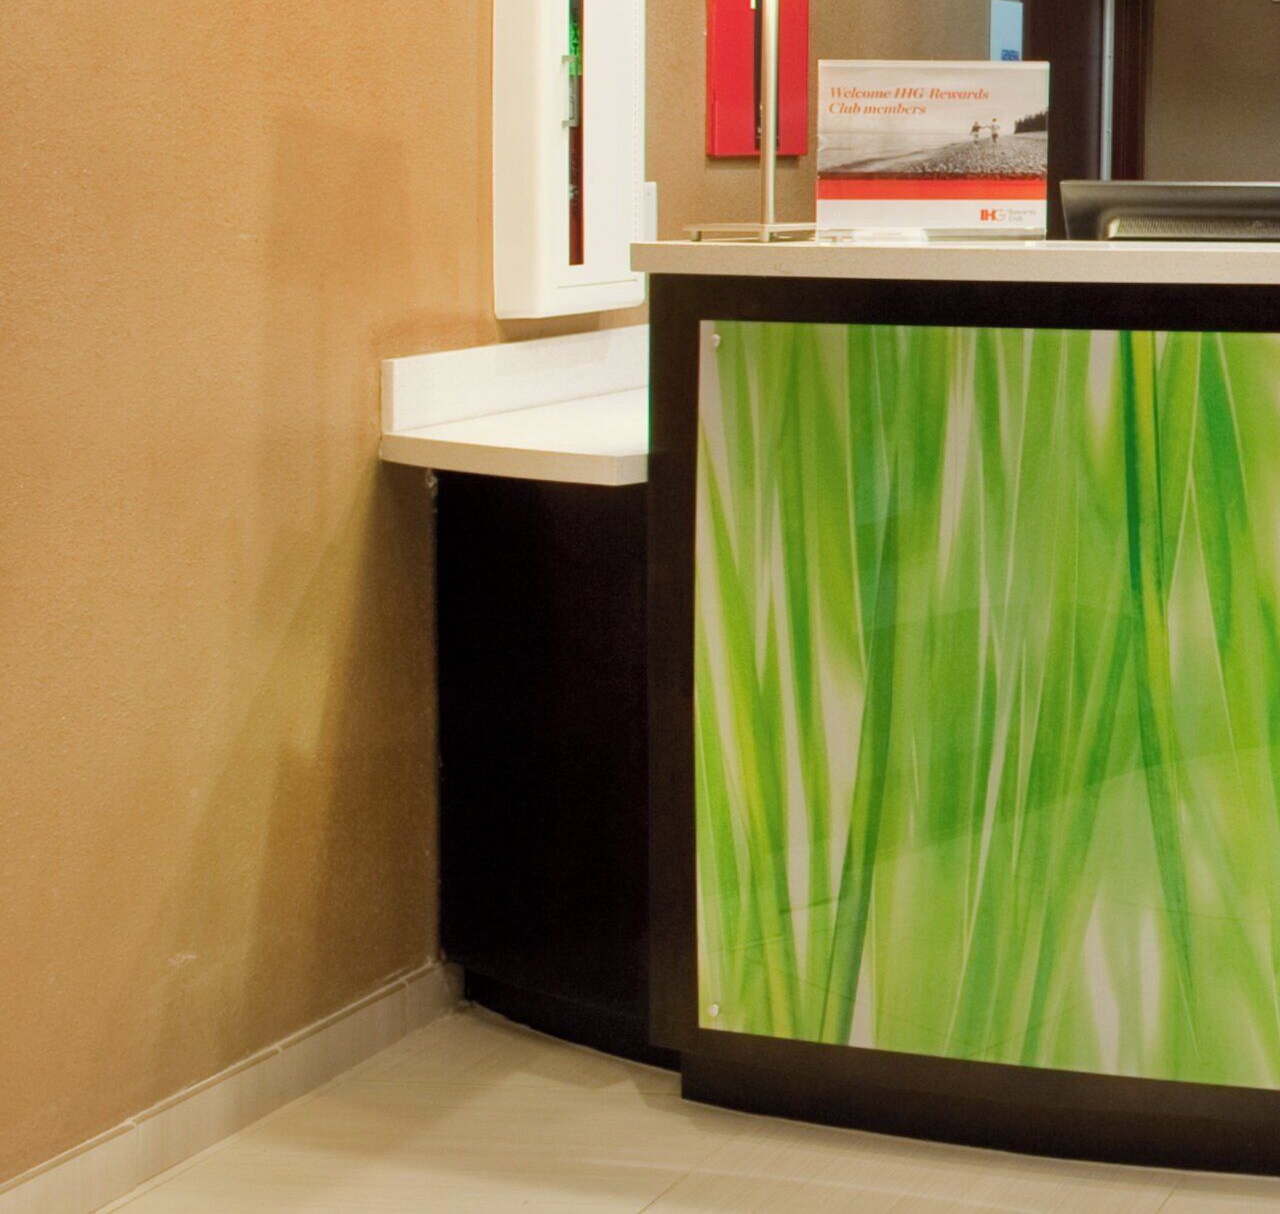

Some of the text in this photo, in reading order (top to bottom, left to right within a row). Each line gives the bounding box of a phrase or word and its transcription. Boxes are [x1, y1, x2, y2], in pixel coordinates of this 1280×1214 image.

[830, 87, 989, 100] Welcome IHG Rewards
[828, 101, 927, 115] Club members
[980, 208, 1006, 222] IHG
